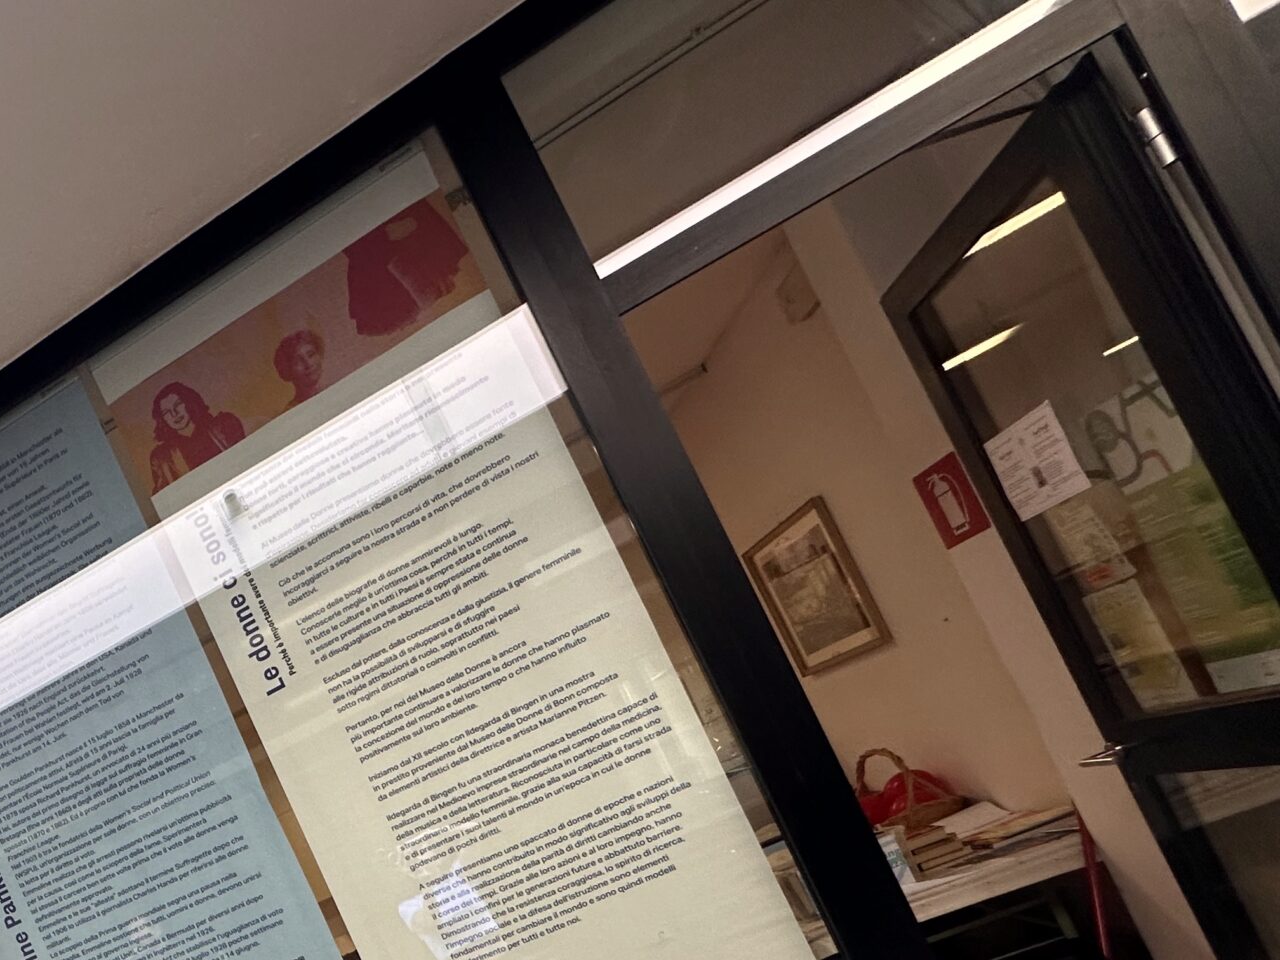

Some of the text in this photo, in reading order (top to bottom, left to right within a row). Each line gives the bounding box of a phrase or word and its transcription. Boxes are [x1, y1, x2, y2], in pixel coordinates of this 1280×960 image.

[278, 576, 291, 587] Ciò
[291, 569, 305, 580] che
[313, 543, 351, 568] accomuna
[351, 532, 370, 546] sono
[373, 523, 389, 534] loro
[389, 503, 422, 527] percorsi
[429, 491, 448, 503] vita,
[447, 481, 463, 493] che
[463, 454, 510, 484] dovrebbero
[186, 507, 285, 696] Le donne ci sono!
[248, 577, 261, 598] avere
[258, 599, 281, 642] importante
[287, 585, 318, 607] obiettivi.
[295, 606, 325, 625] L'elenco
[325, 596, 344, 609] delle
[343, 578, 377, 599] biografie
[385, 562, 410, 577] donne
[410, 537, 452, 565] ammirevoli
[457, 522, 483, 538] lungo.
[278, 648, 296, 676] Perché
[344, 713, 380, 733] Pertanto,
[379, 706, 392, 718] per
[393, 698, 406, 709] noi
[406, 691, 419, 703] del
[418, 680, 445, 696] Museo
[445, 671, 464, 684] delle
[463, 658, 491, 674] Donne
[498, 640, 527, 658] ancora
[367, 764, 399, 782] Iniziamo
[399, 757, 412, 767] dal
[411, 751, 423, 761] XII
[422, 740, 449, 756] secolo
[449, 733, 465, 743] con
[464, 716, 501, 736] Ildegarda
[509, 697, 539, 715] Bingen
[548, 685, 564, 697] una
[564, 671, 595, 689] mostra
[388, 776, 420, 797] elementi
[421, 763, 450, 781] artistici
[450, 755, 469, 768] della
[469, 739, 505, 759] direttrice
[512, 723, 539, 739] artista
[538, 705, 577, 726] Marianne
[576, 692, 606, 708] Pitzen.
[449, 934, 501, 960] fondamentali
[500, 930, 514, 941] per
[515, 915, 553, 934] cambiare
[558, 900, 588, 916] mondo
[595, 889, 616, 901] sono
[617, 876, 644, 893] quindi
[644, 863, 676, 881] modelli
